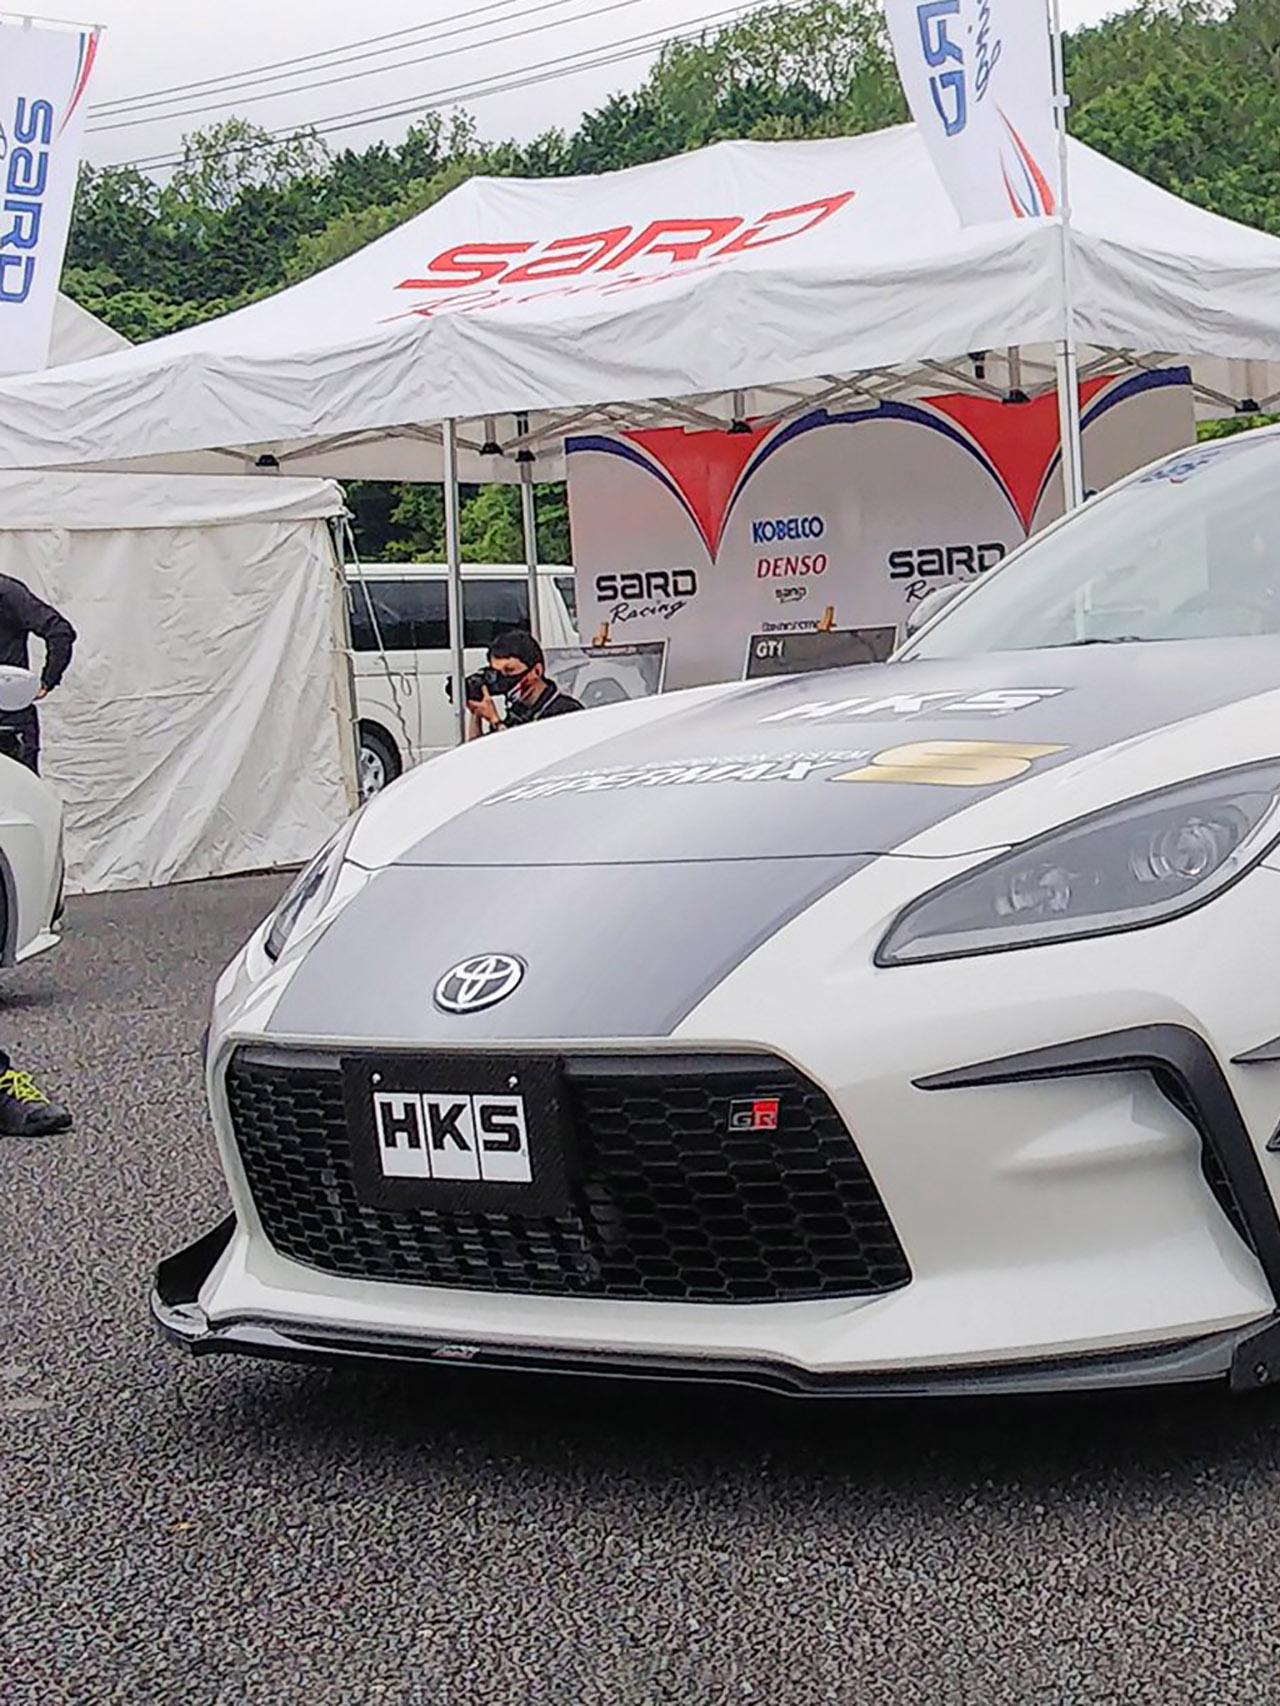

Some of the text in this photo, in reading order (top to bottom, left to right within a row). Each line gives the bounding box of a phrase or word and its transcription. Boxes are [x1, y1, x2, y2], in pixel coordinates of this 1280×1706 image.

[0, 96, 53, 303] SARD
[393, 191, 856, 291] SARD
[753, 516, 824, 543] KOBELCO
[757, 554, 827, 578] DENSO
[889, 543, 1005, 579] SARD
[596, 569, 697, 602] SARD
[609, 600, 687, 624] Racing
[757, 688, 1068, 723] HKS
[379, 1101, 521, 1152] HKS
[732, 1110, 778, 1128] GR
